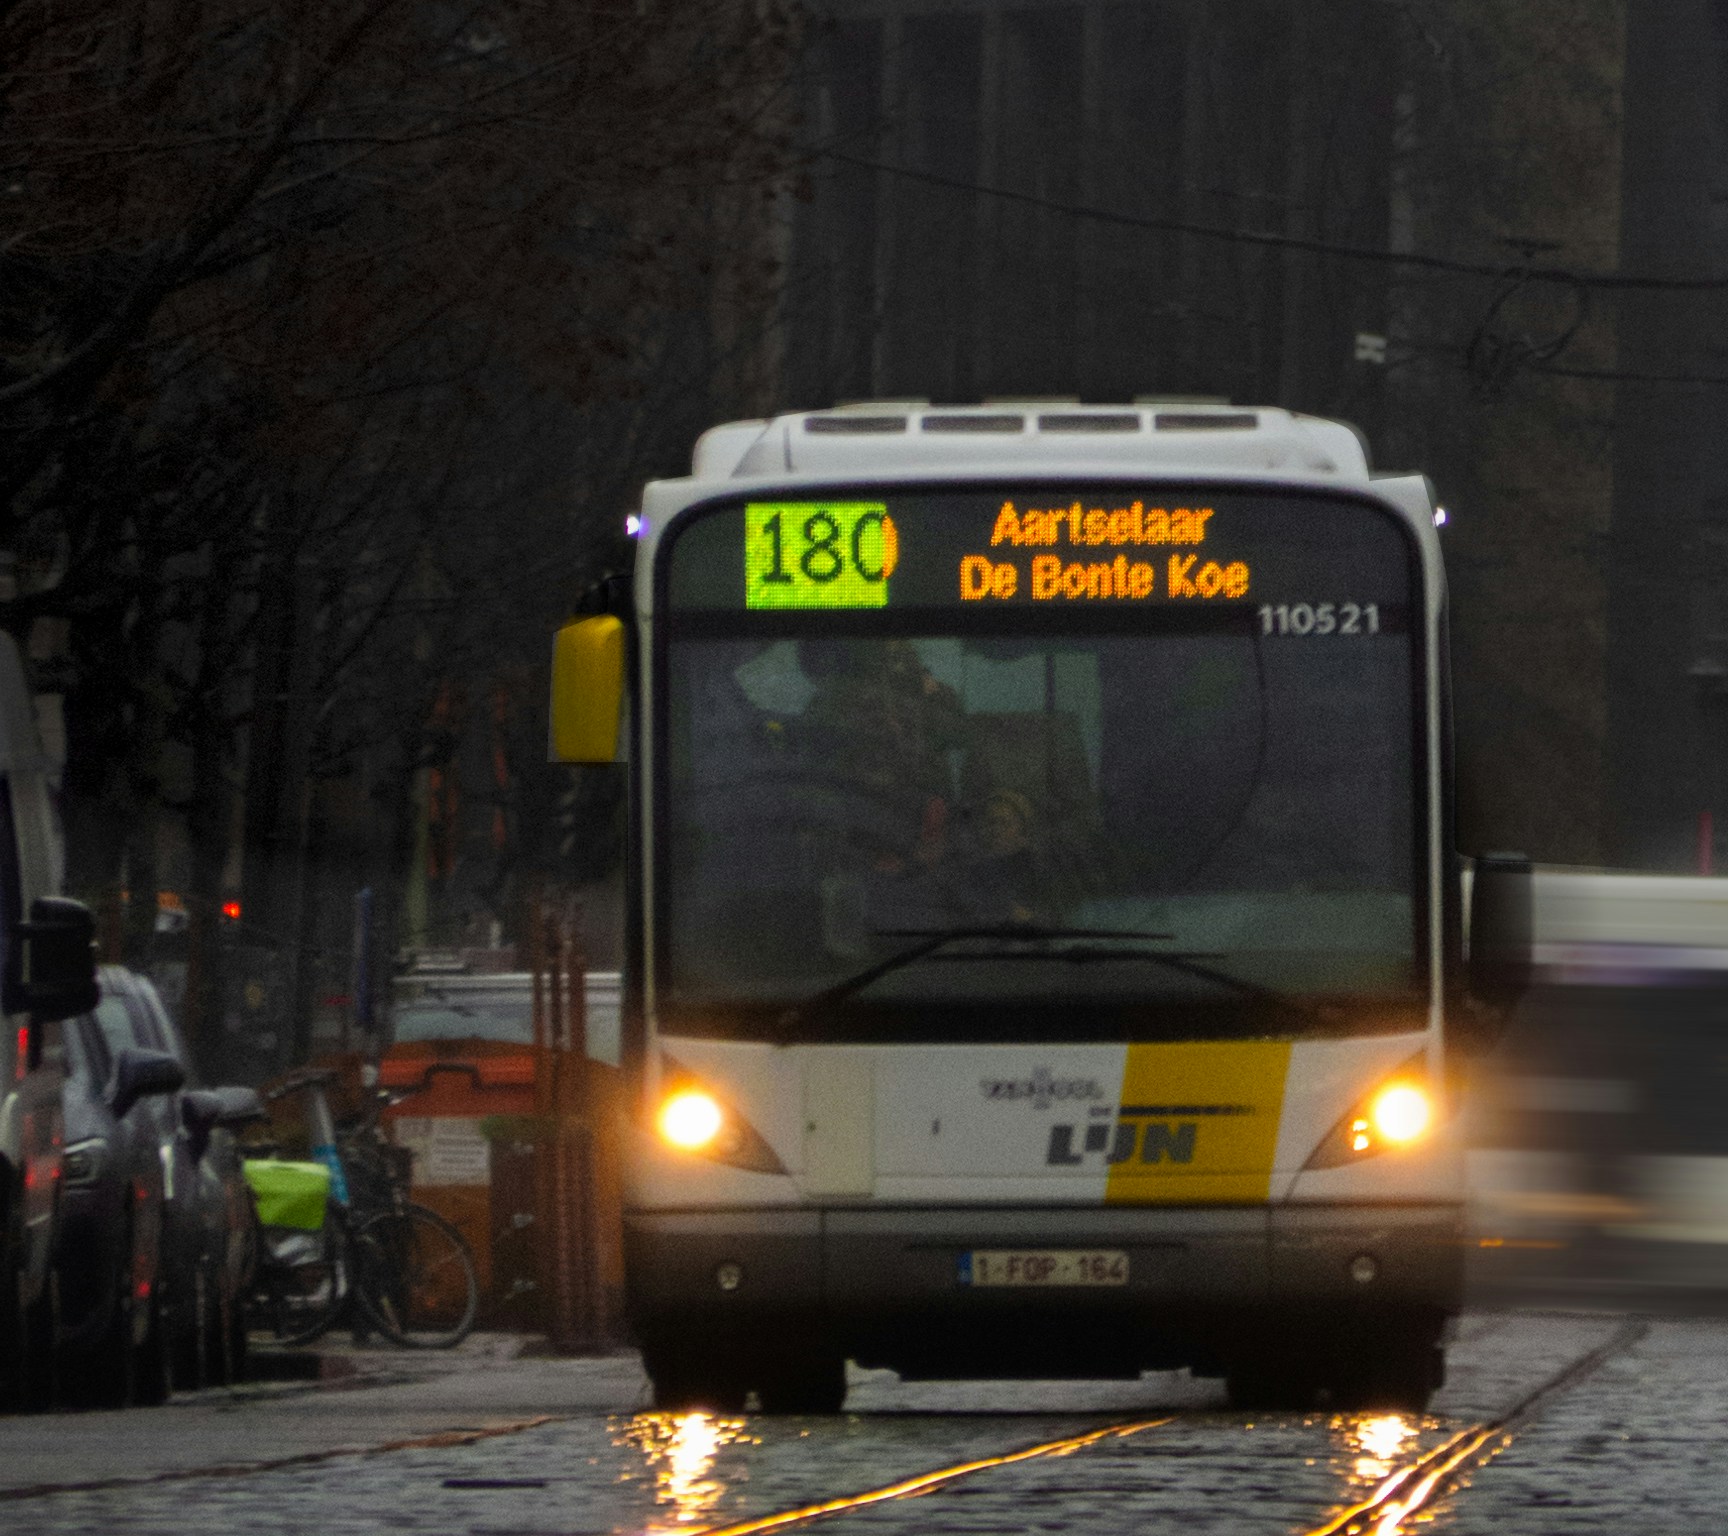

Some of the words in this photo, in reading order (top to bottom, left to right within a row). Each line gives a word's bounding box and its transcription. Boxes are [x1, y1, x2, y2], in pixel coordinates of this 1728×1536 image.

[763, 510, 899, 583] 180
[991, 501, 1214, 546] Aartselaar
[960, 555, 1017, 600] De
[1032, 553, 1153, 600] Bonte
[1169, 553, 1249, 599] Koe
[1258, 603, 1379, 634] 110521
